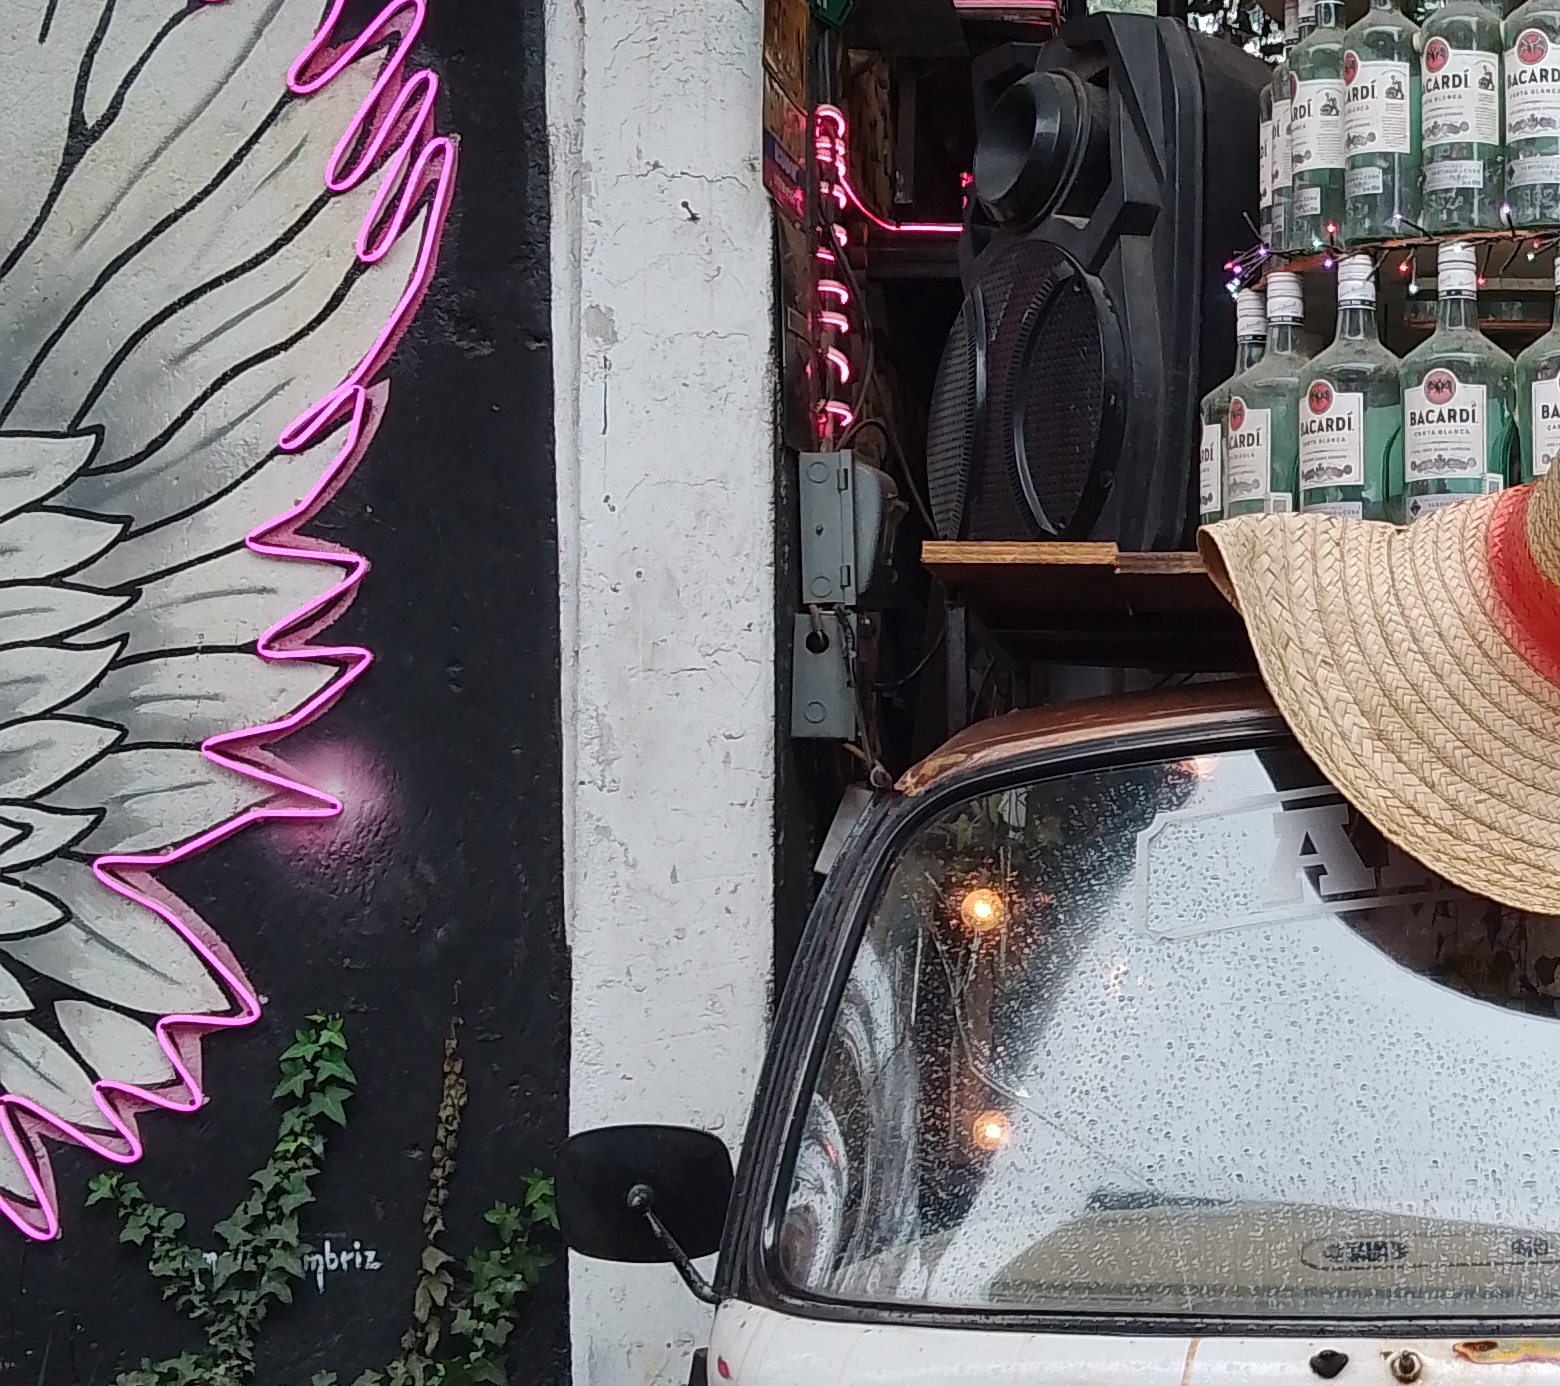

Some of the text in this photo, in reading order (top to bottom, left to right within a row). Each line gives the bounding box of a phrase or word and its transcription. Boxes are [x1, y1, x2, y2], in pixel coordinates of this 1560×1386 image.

[1346, 79, 1377, 103] ARDÍ
[1410, 401, 1478, 426] BACARDÍ
[1229, 427, 1262, 449] CARDÍ
